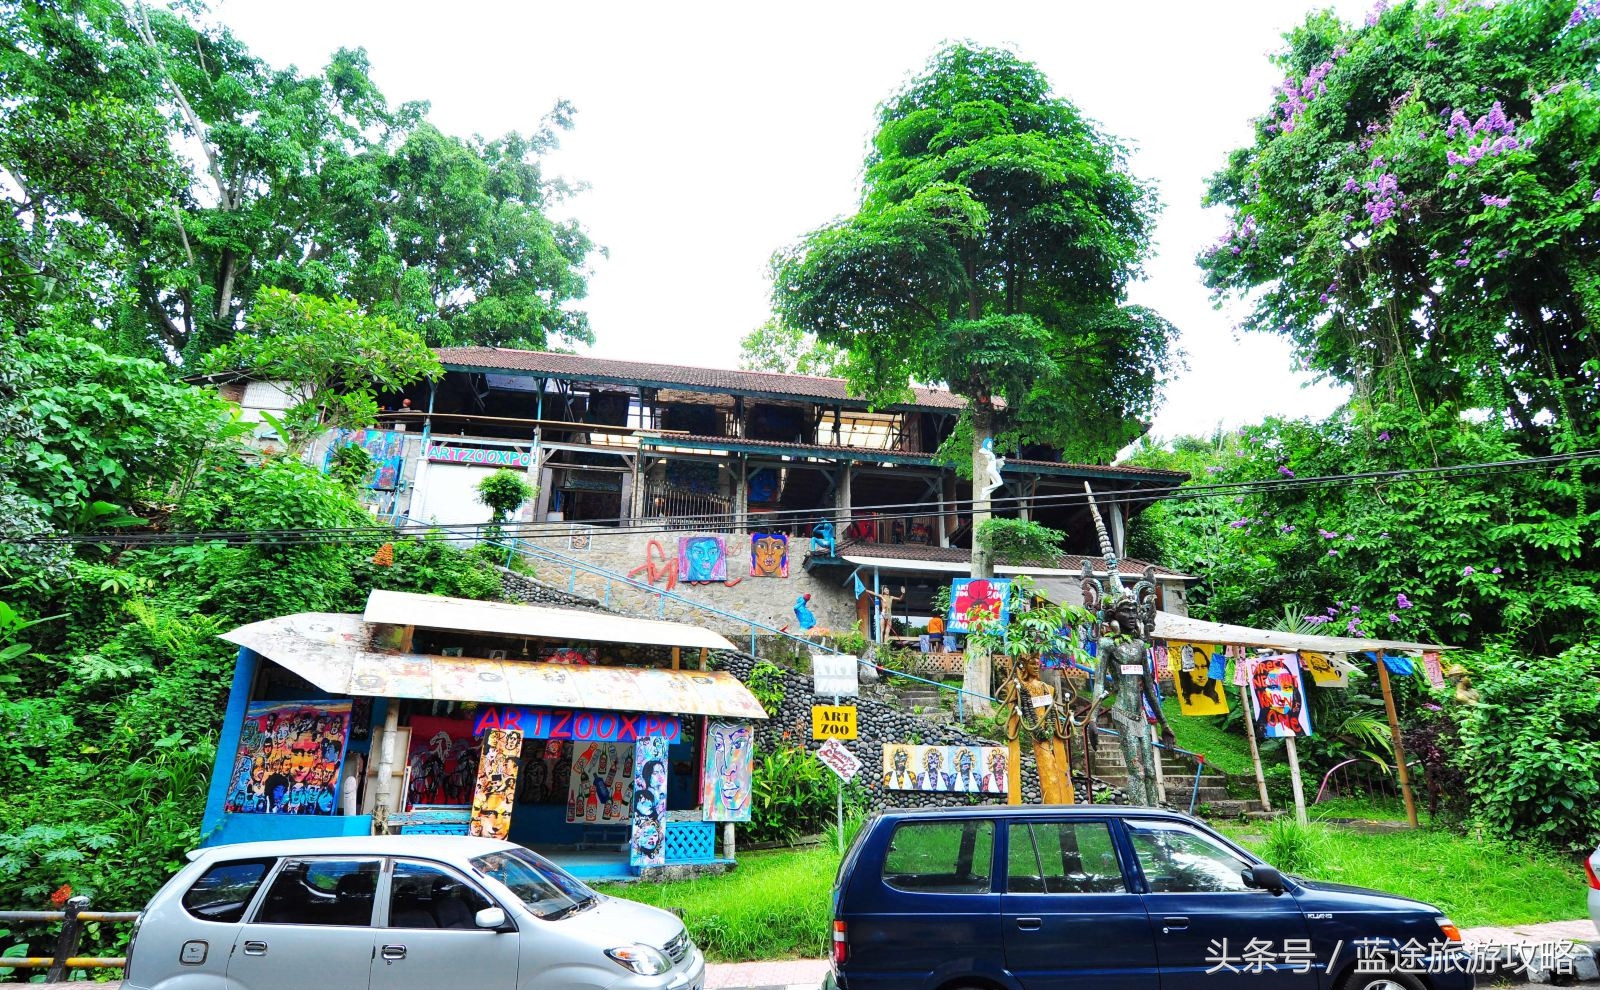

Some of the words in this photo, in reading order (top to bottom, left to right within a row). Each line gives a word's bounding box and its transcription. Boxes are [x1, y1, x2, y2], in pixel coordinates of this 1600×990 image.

[428, 445, 531, 466] ARTZOOXPO
[476, 706, 679, 741] ARTZOOXPO
[821, 711, 851, 722] ART
[821, 724, 849, 735] ZOO
